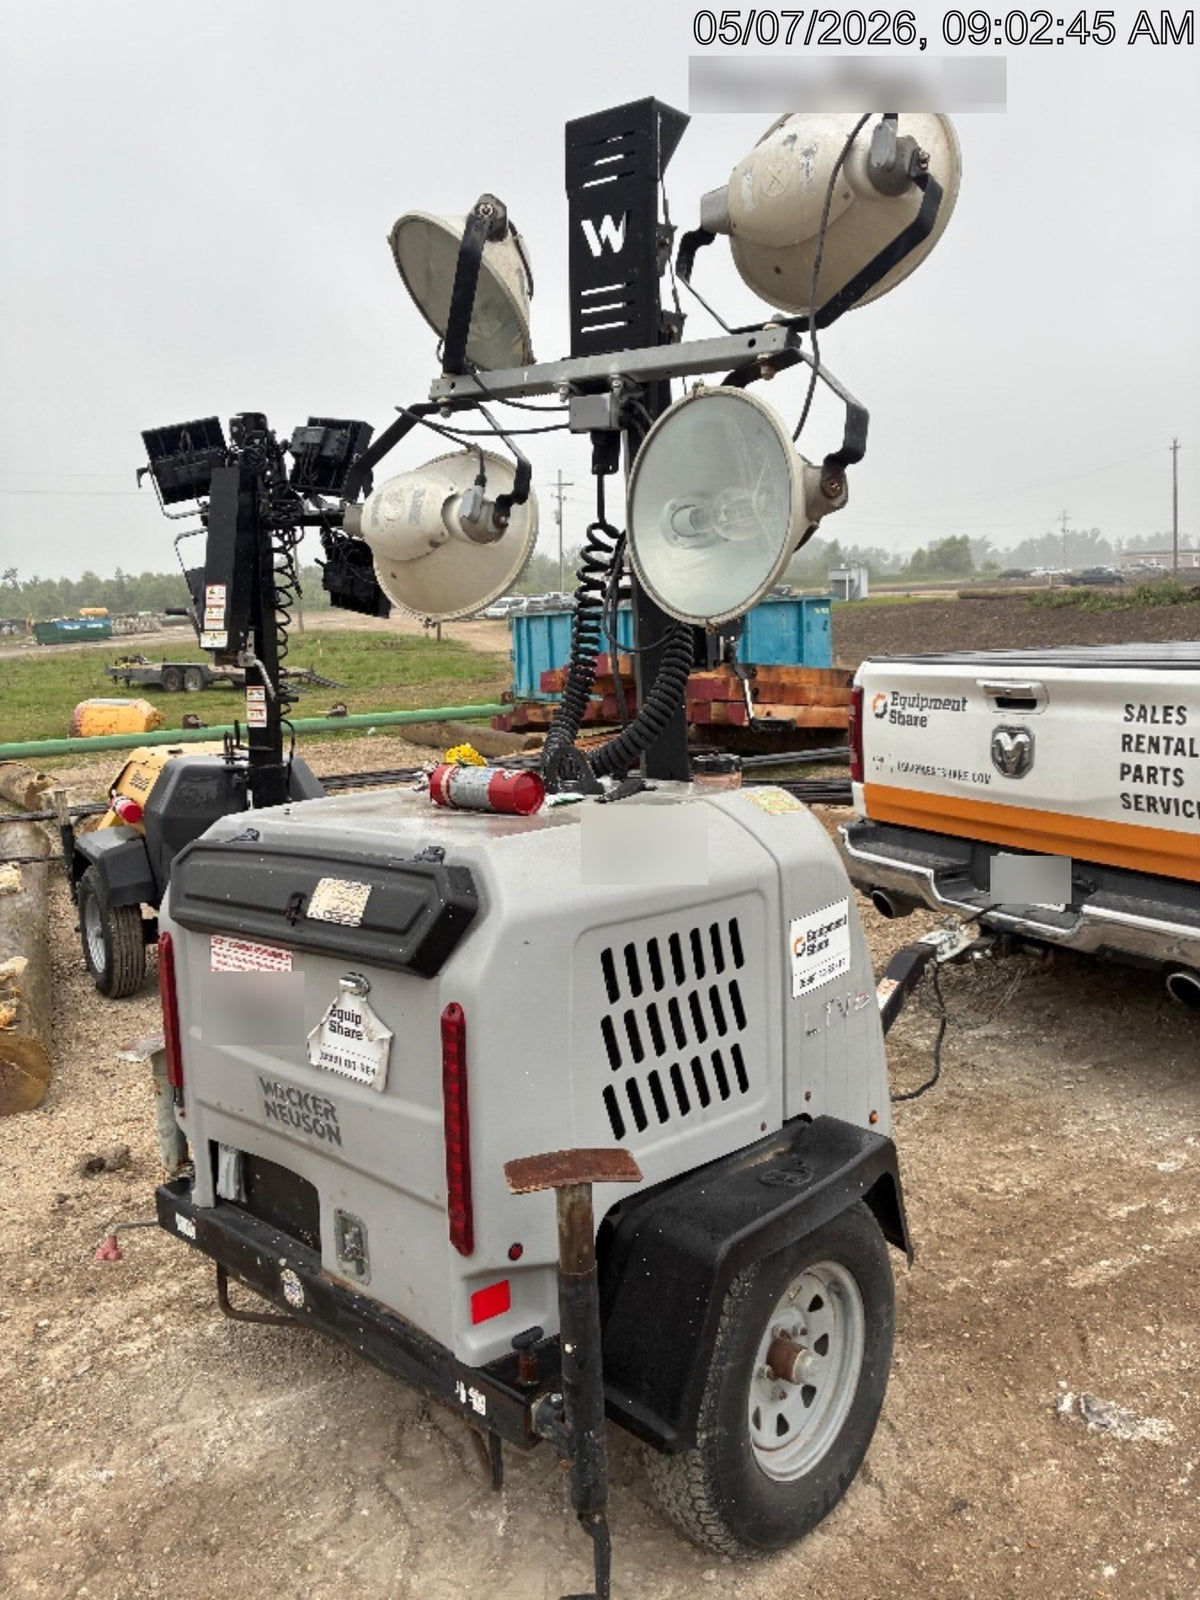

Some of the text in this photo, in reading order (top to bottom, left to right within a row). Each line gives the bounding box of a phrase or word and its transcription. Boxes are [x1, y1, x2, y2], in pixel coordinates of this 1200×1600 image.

[890, 691, 968, 712] Equipment
[889, 709, 928, 728] Share
[1123, 703, 1188, 726] SALES
[1121, 733, 1200, 758] RENTAL
[1119, 762, 1185, 788] PARTS
[1119, 792, 1200, 820] SERVIC
[328, 1020, 363, 1041] Share
[258, 1076, 338, 1123] WACKER
[264, 1100, 342, 1146] NEUSON
